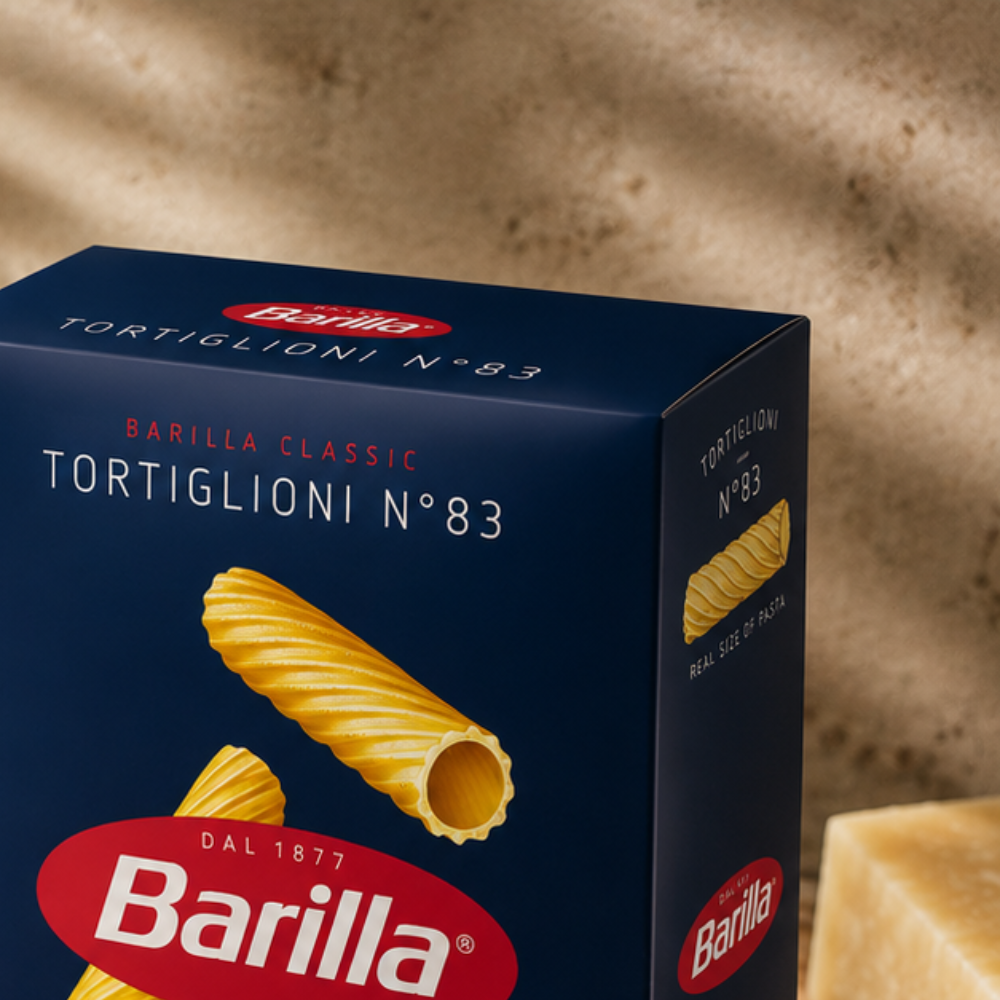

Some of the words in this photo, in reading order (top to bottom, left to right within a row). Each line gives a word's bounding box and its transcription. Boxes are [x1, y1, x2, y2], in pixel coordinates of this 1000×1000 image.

[58, 317, 378, 362] TORTIGLIONI
[126, 417, 257, 452] BARILLA
[280, 436, 417, 471] CLASSIC
[700, 408, 778, 477] TORTIGLIONI
[43, 449, 351, 524] TORTIGLIONI
[690, 651, 715, 680] REAL
[758, 594, 786, 627] PASTA
[201, 832, 256, 856] DAL
[274, 841, 345, 871] 1877
